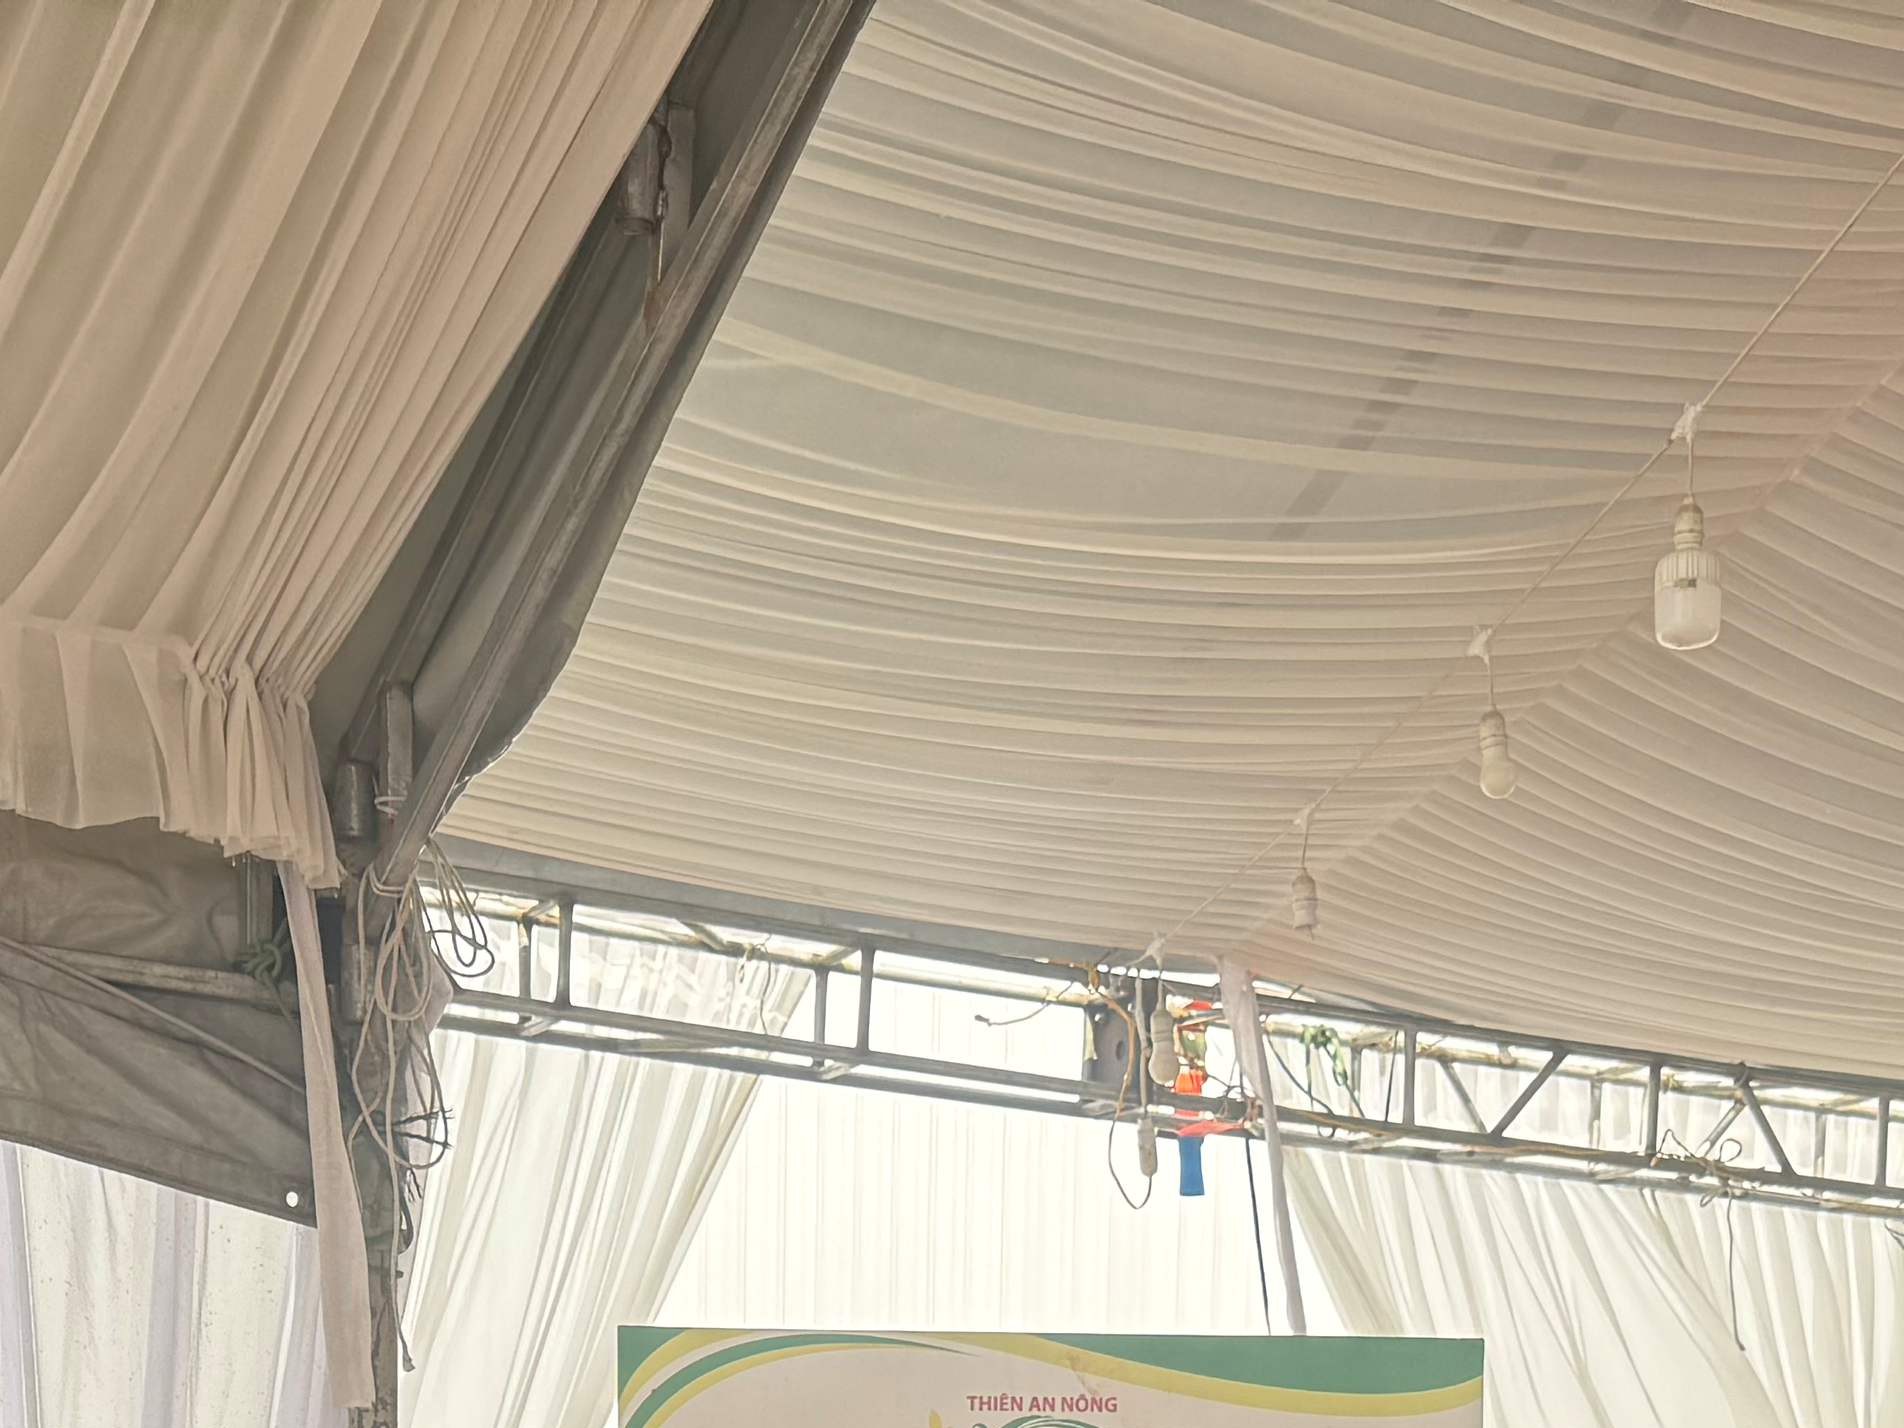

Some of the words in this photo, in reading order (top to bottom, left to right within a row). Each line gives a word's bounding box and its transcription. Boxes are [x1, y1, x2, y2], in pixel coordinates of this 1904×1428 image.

[966, 1394, 1026, 1414] THIÊN
[1028, 1397, 1056, 1414] AN
[1060, 1394, 1119, 1415] NÔNG
